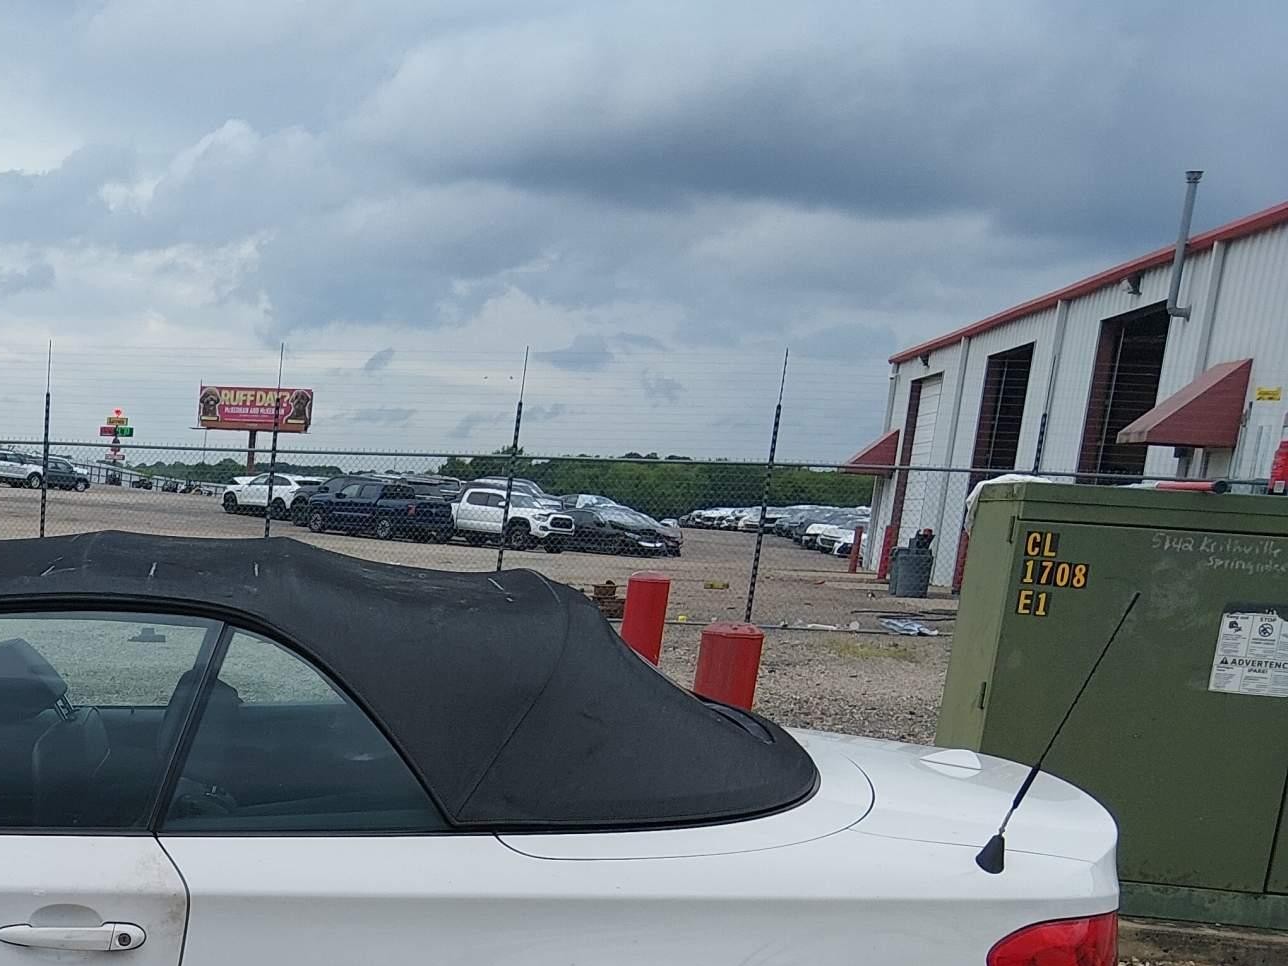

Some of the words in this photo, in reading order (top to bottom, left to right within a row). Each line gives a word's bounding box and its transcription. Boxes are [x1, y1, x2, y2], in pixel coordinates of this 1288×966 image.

[221, 389, 255, 405] RUFF
[256, 391, 290, 407] DAY?
[1026, 532, 1057, 557] CL
[1023, 559, 1087, 588] 1708
[1017, 590, 1047, 616] E1
